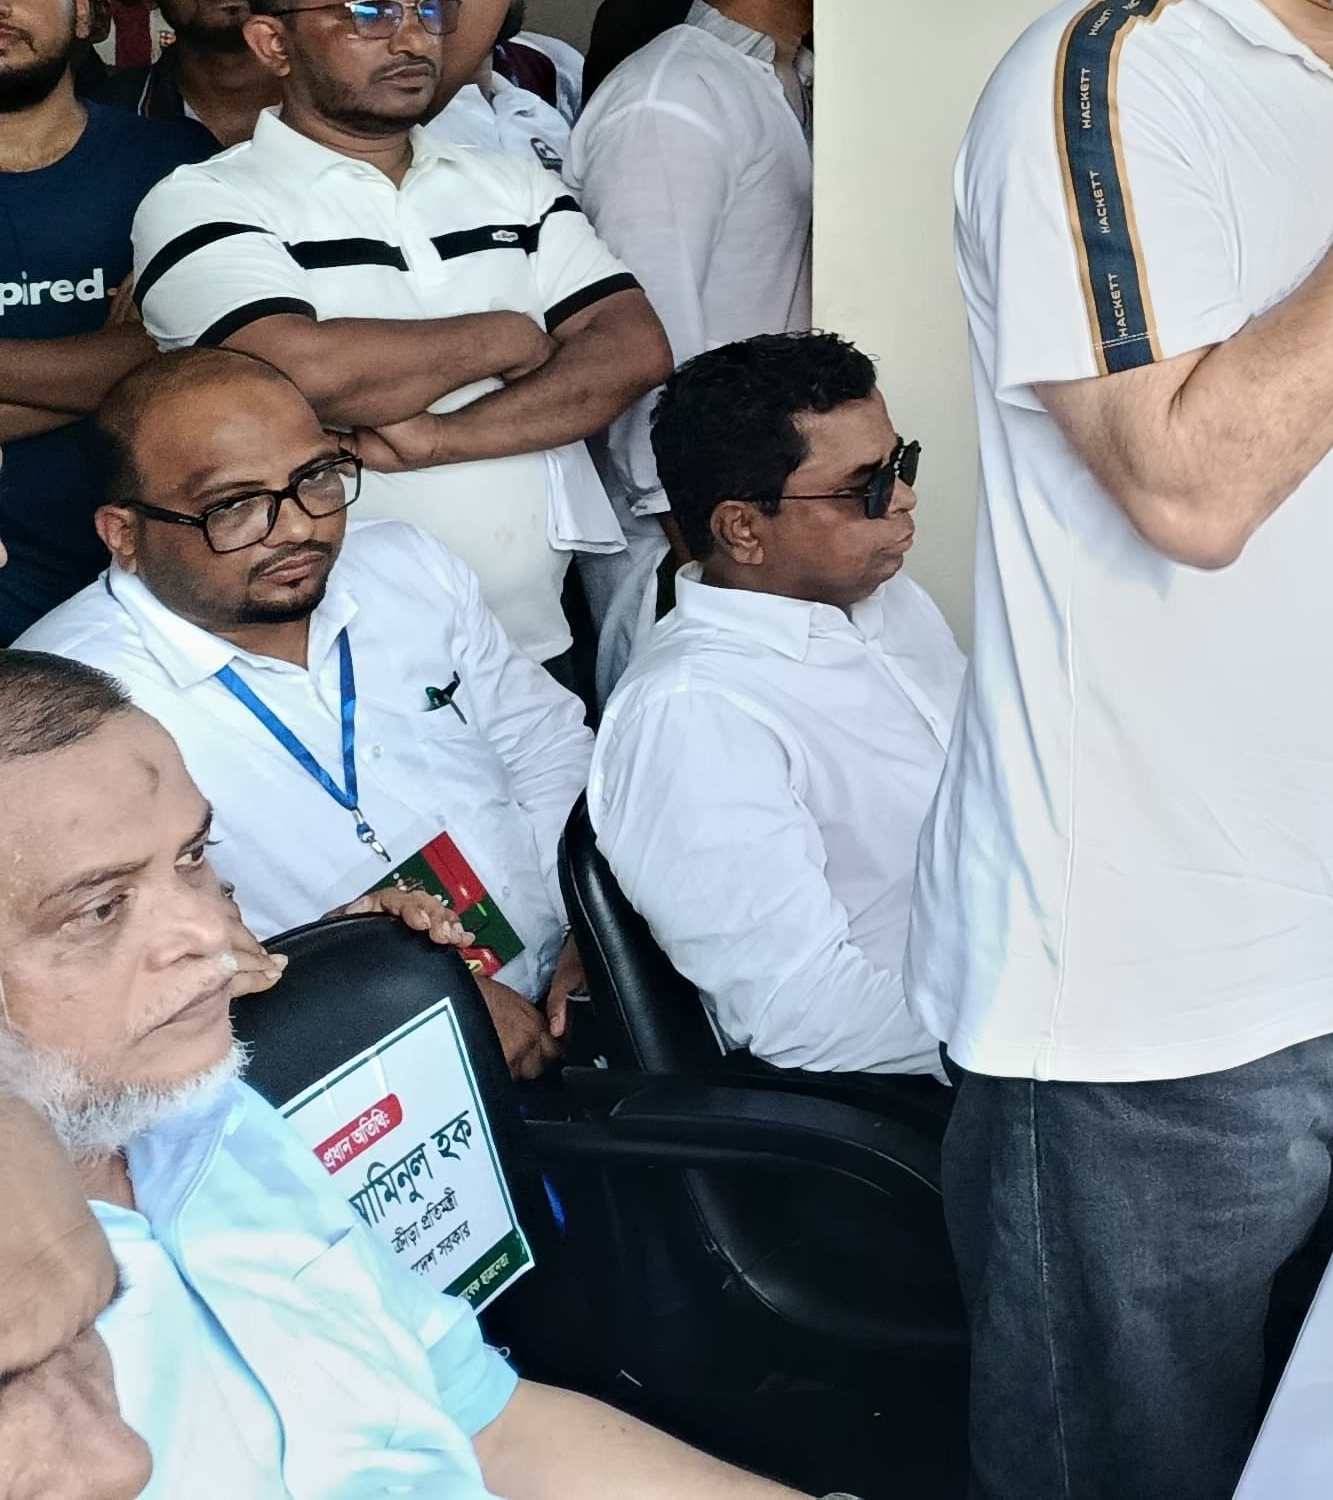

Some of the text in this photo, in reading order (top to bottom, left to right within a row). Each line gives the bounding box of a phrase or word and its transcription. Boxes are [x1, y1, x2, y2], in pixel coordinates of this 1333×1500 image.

[1080, 67, 1093, 129] HACKETT
[1089, 170, 1111, 234] HACKETT
[1107, 273, 1129, 338] HACKETT
[323, 1136, 354, 1169] প্রধান
[430, 1110, 473, 1160] হক
[438, 1220, 471, 1257] সরকার
